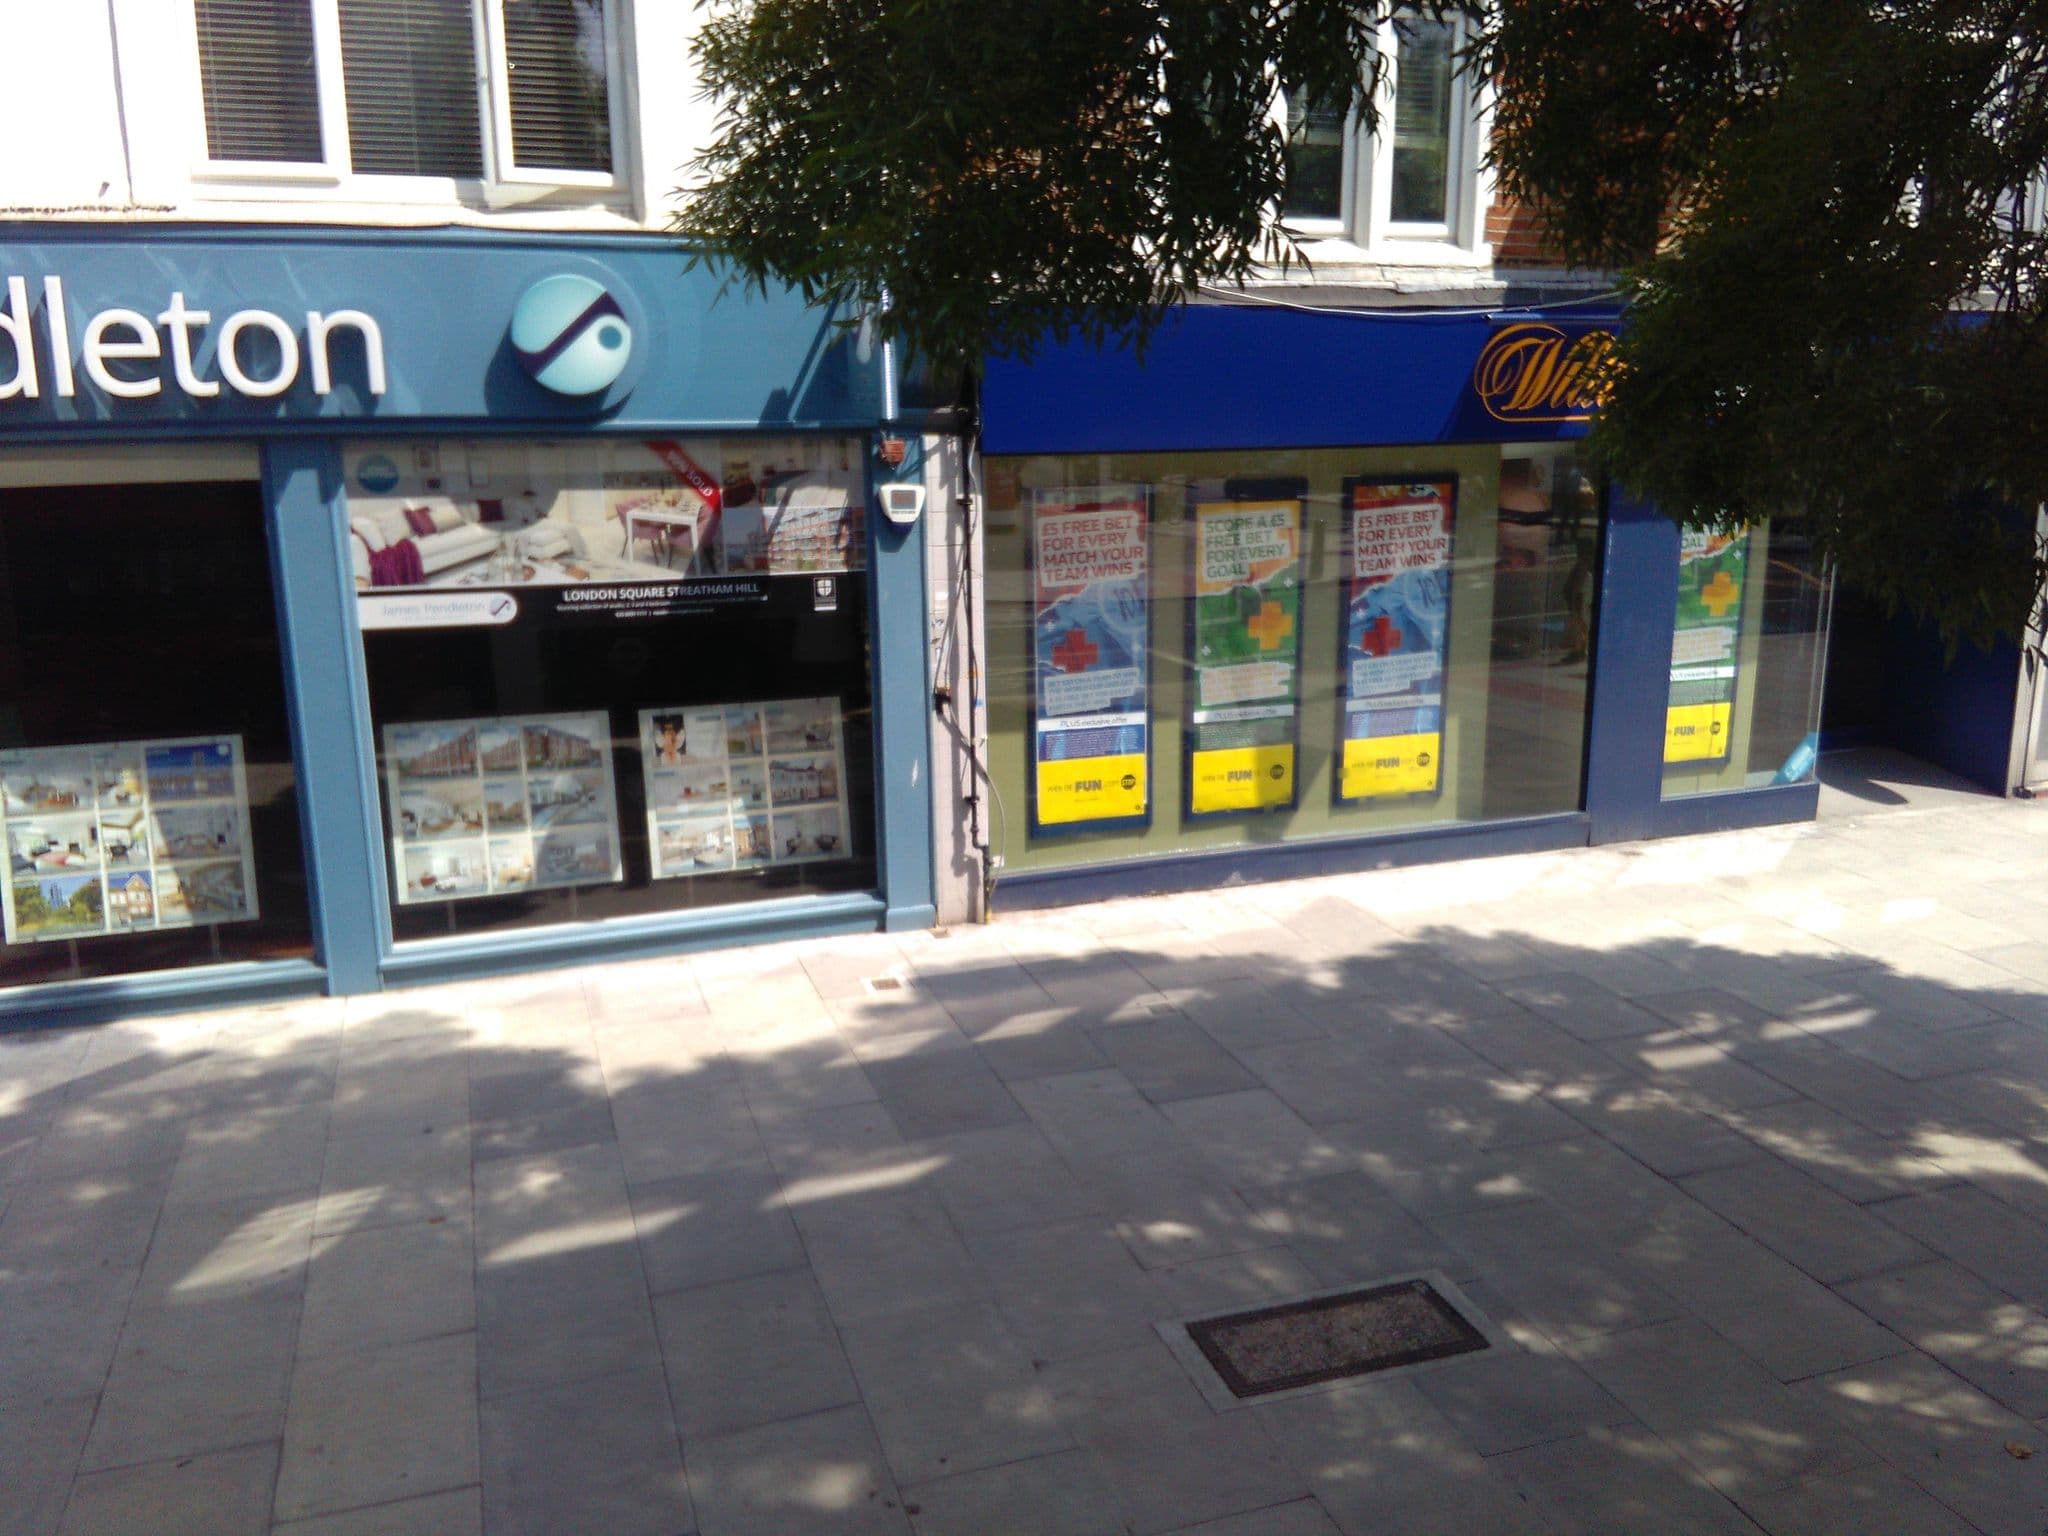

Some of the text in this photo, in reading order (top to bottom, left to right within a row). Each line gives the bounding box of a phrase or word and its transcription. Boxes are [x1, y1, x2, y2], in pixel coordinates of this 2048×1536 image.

[0, 275, 386, 398] dleton
[1062, 519, 1100, 533] FREE
[1104, 515, 1133, 530] BET
[1257, 515, 1267, 528] A
[1376, 512, 1408, 526] FREE
[1413, 509, 1438, 523] BET
[1043, 532, 1127, 552] FOR EVERY
[1206, 530, 1272, 547] FREE BET
[1358, 525, 1432, 543] FOR EVERY
[1206, 543, 1285, 563] FOR EVERY
[1358, 537, 1446, 557] MATCH YOUR
[1044, 546, 1144, 567] MATCH YOUR
[1358, 552, 1435, 572] TEAM WINS
[1043, 562, 1134, 581] TEAM WINS
[1206, 563, 1246, 579] GOAL
[563, 587, 618, 602] LONDON
[619, 586, 665, 600] SQUARE
[667, 584, 733, 597] STREATHAM
[735, 582, 760, 593] HILL
[1674, 725, 1696, 736] FUN
[1375, 756, 1400, 770] FUN
[1227, 769, 1253, 783] FUN
[1075, 779, 1102, 793] FUN
